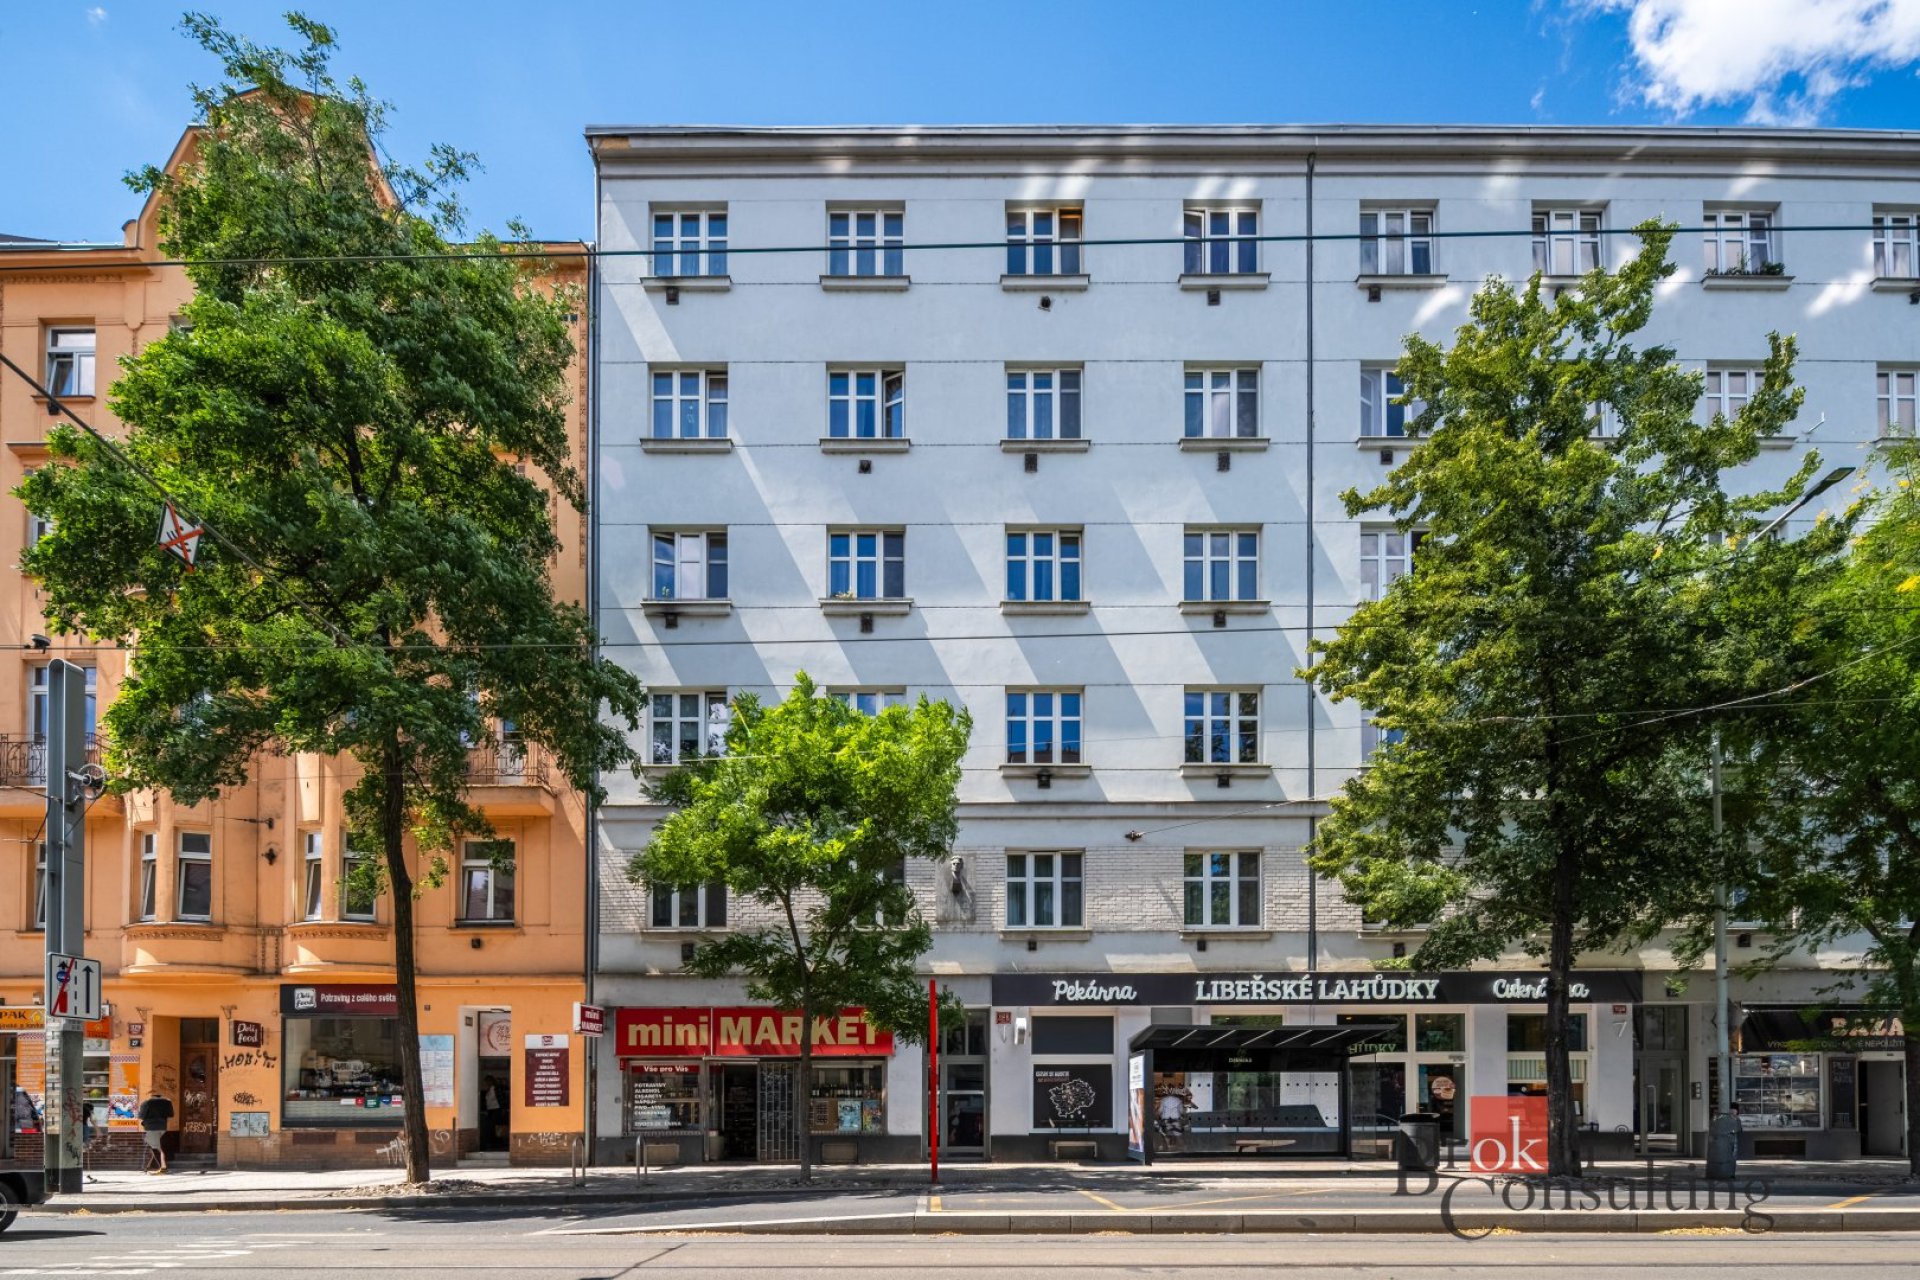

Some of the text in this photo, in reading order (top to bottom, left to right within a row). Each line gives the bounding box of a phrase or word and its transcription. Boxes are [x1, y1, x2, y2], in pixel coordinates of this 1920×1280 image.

[1052, 979, 1137, 1001] Pekárna
[1196, 974, 1440, 1000] LIBEŘSKÉ LAHŮDKY
[1493, 977, 1590, 999] Cukráa
[320, 994, 350, 1004] Potraviny
[356, 993, 377, 1002] celého
[378, 993, 397, 1002] světa
[585, 1010, 600, 1019] mini
[237, 1023, 255, 1034] Deli
[582, 1021, 603, 1032] MARKET
[628, 1016, 880, 1046] mini MARKET
[1612, 1021, 1627, 1038] 7
[237, 1029, 258, 1044] food
